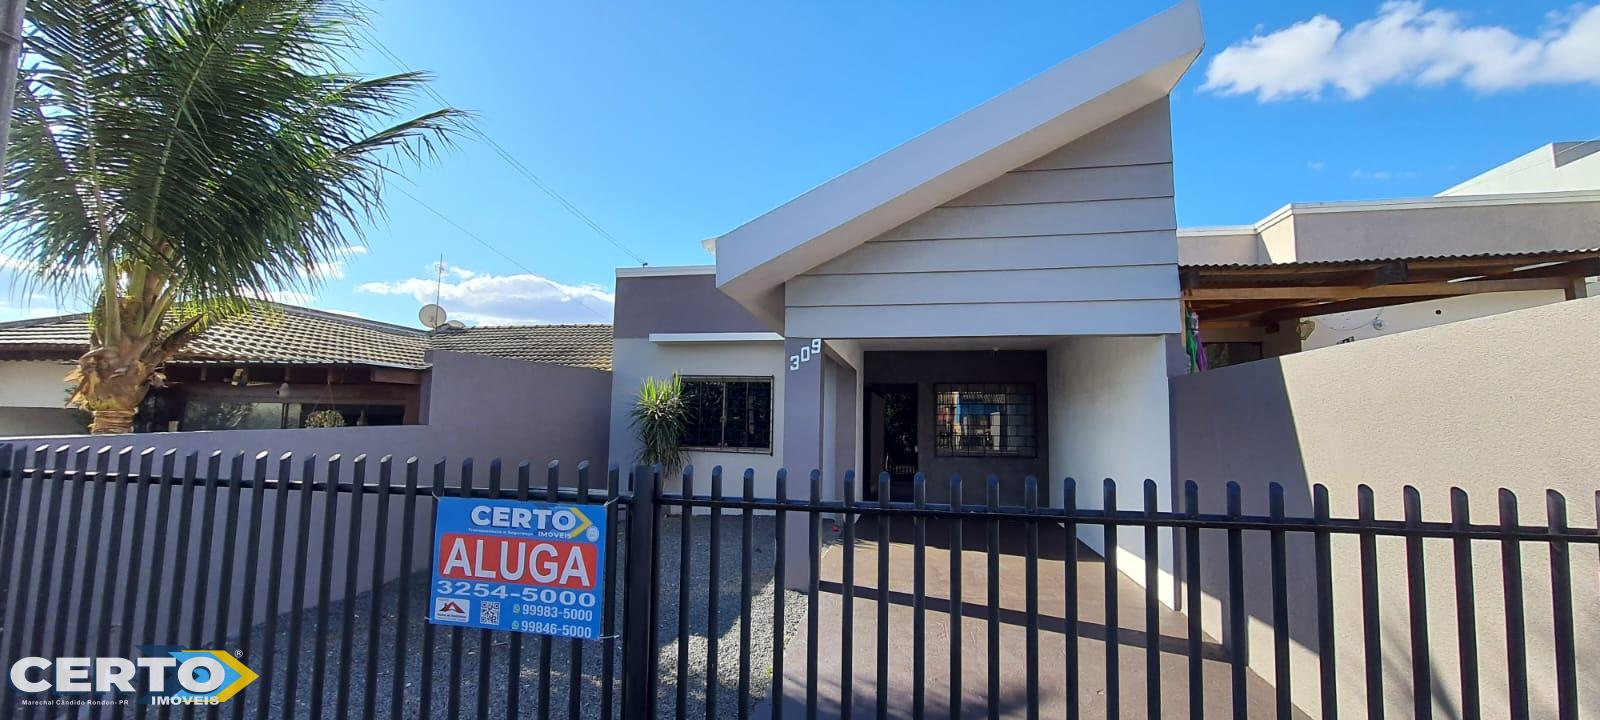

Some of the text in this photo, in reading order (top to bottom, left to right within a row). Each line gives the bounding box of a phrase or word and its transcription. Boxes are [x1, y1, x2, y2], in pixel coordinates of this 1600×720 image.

[790, 338, 821, 370] 309
[471, 505, 577, 531] CERTO
[443, 537, 591, 587] ALUGA
[437, 580, 596, 607] 3254-5000
[522, 603, 593, 621] 99983-5000
[521, 620, 592, 639] 99846-5000
